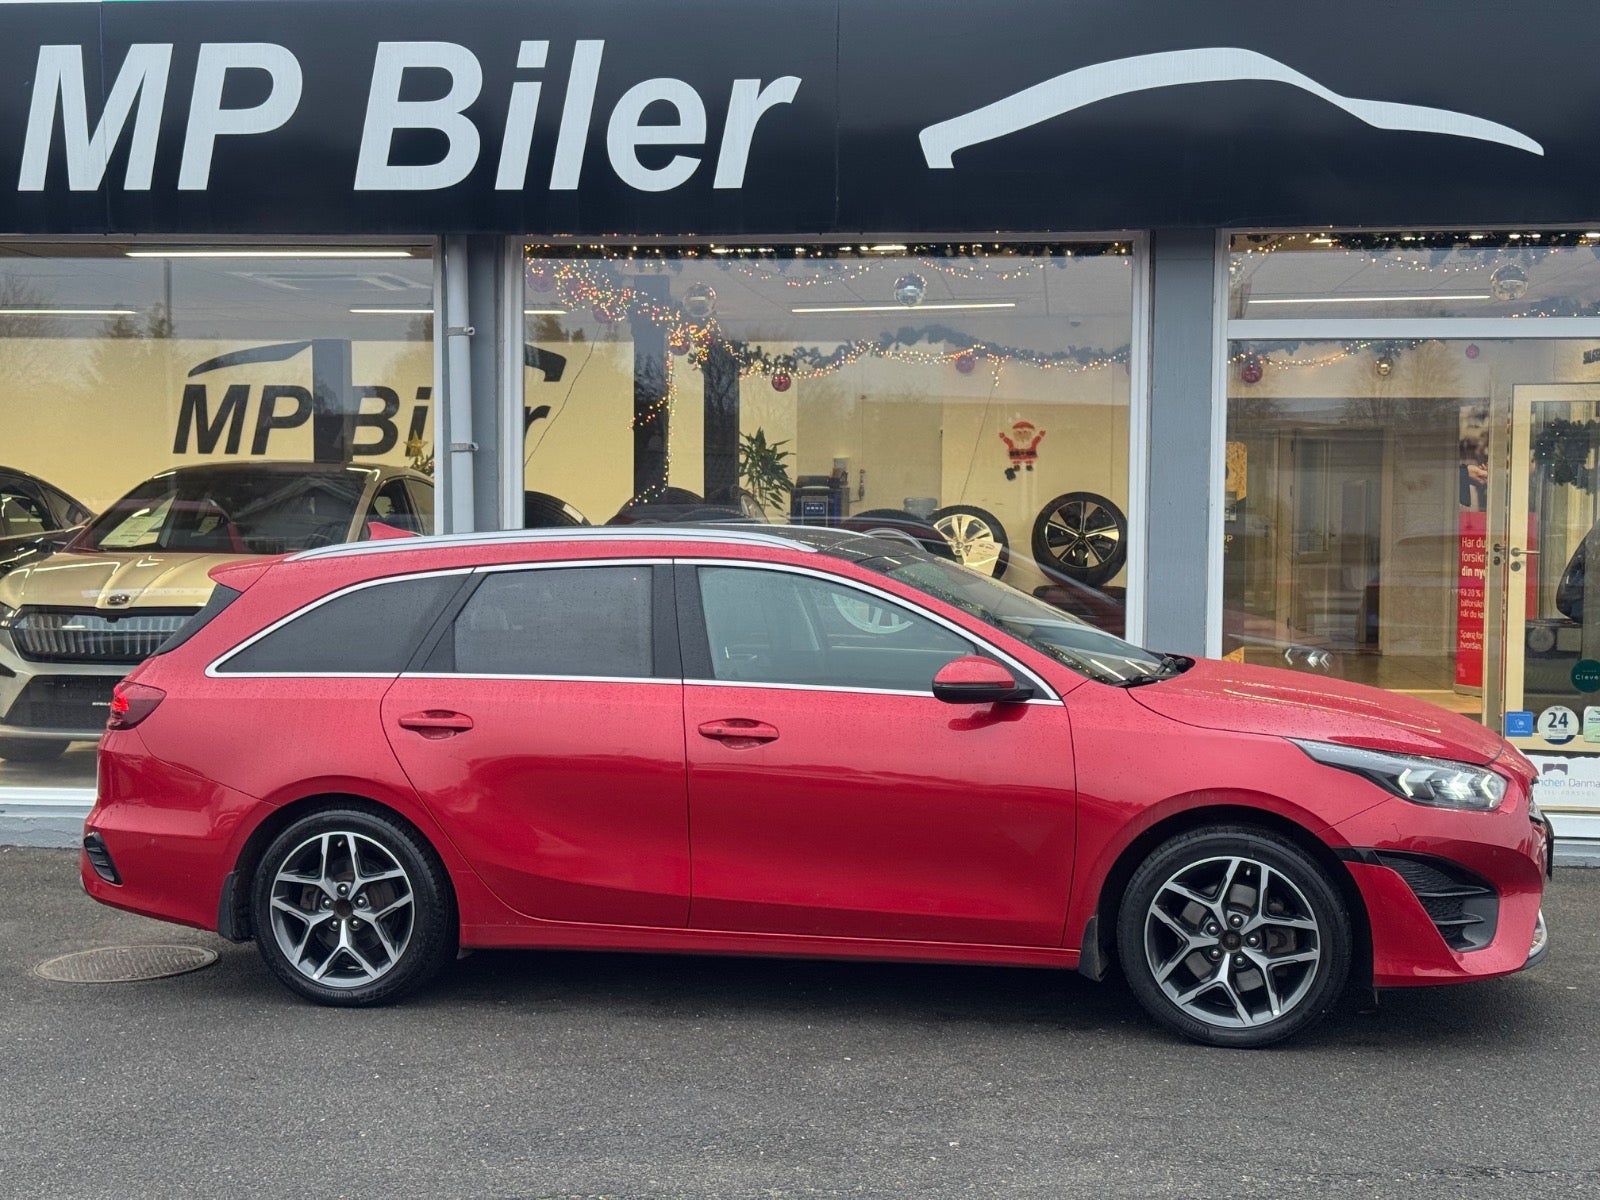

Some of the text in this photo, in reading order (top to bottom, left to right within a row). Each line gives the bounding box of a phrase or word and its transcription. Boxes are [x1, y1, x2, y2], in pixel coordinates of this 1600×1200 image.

[17, 39, 803, 193] MP Biler
[172, 384, 552, 457] MP Bir
[1461, 536, 1486, 549] Har du
[1461, 565, 1473, 577] din
[1547, 711, 1569, 729] 24
